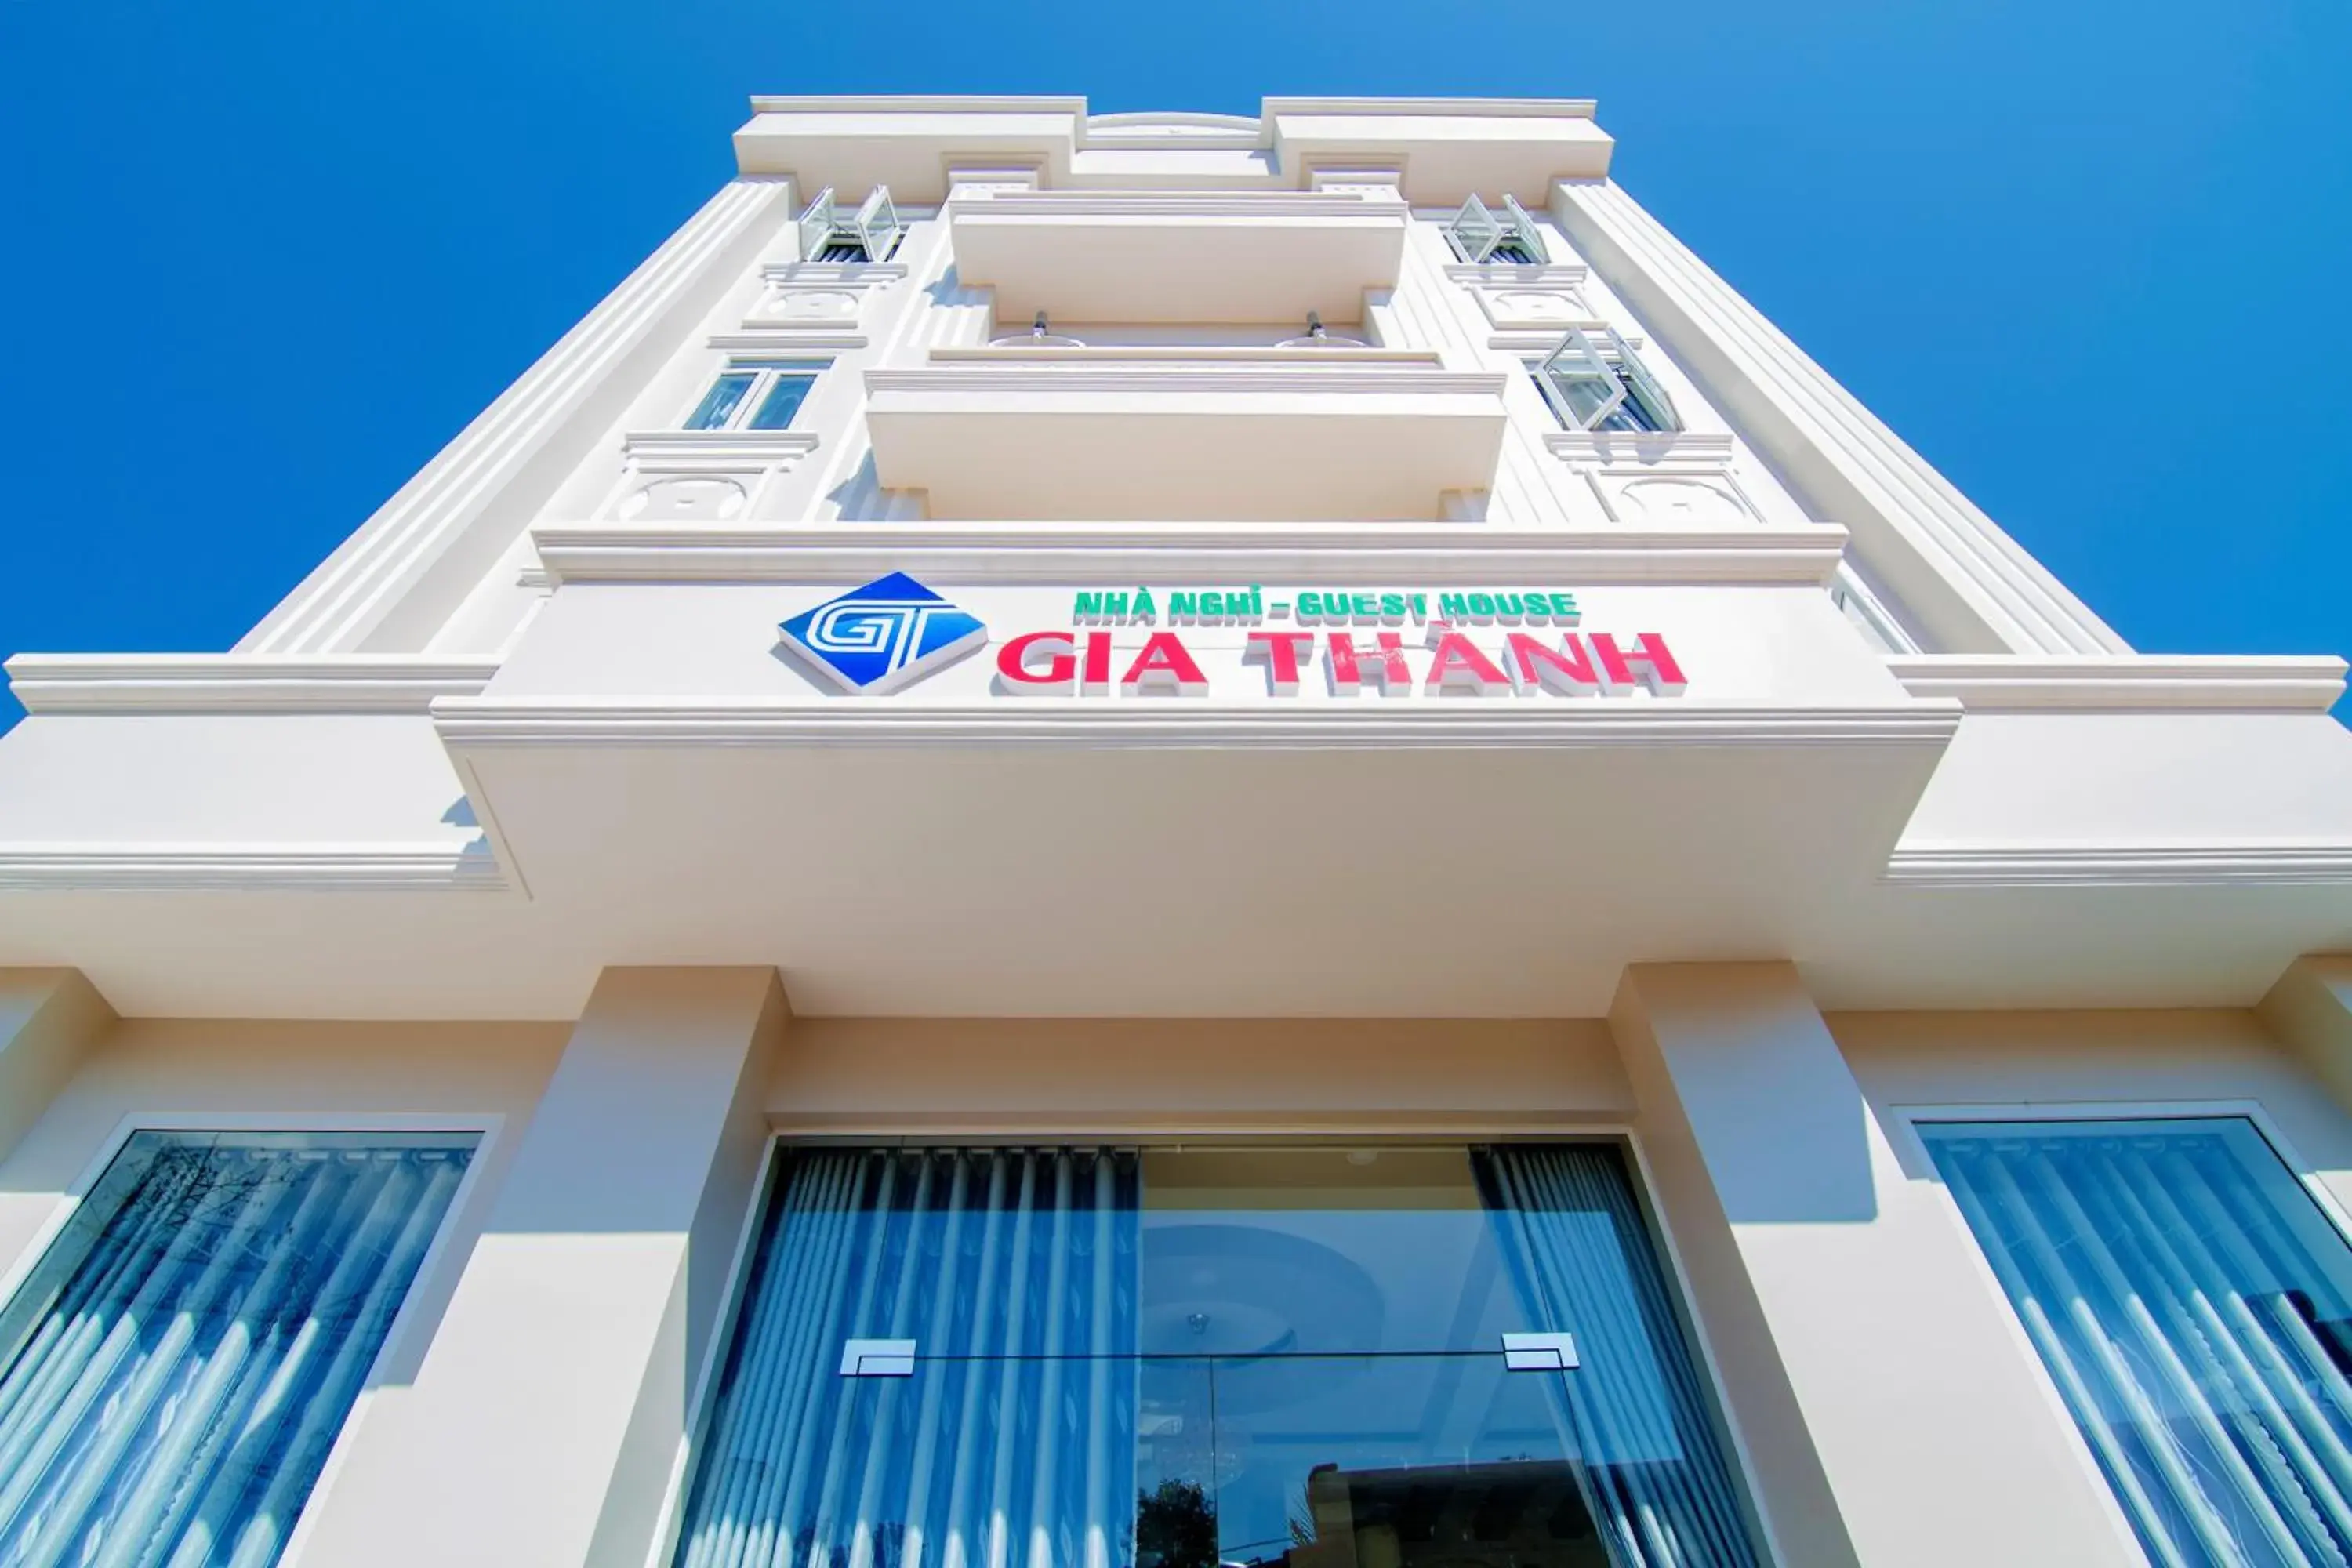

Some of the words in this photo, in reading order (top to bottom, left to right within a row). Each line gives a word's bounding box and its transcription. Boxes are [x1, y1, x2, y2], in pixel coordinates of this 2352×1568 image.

[1074, 586, 1156, 616] NHÀ
[1297, 592, 1428, 616] GUEST
[1440, 593, 1580, 616] HOUSE
[806, 599, 968, 673] GT
[996, 631, 1207, 684] GIA
[1248, 620, 1687, 684] THÀNH
